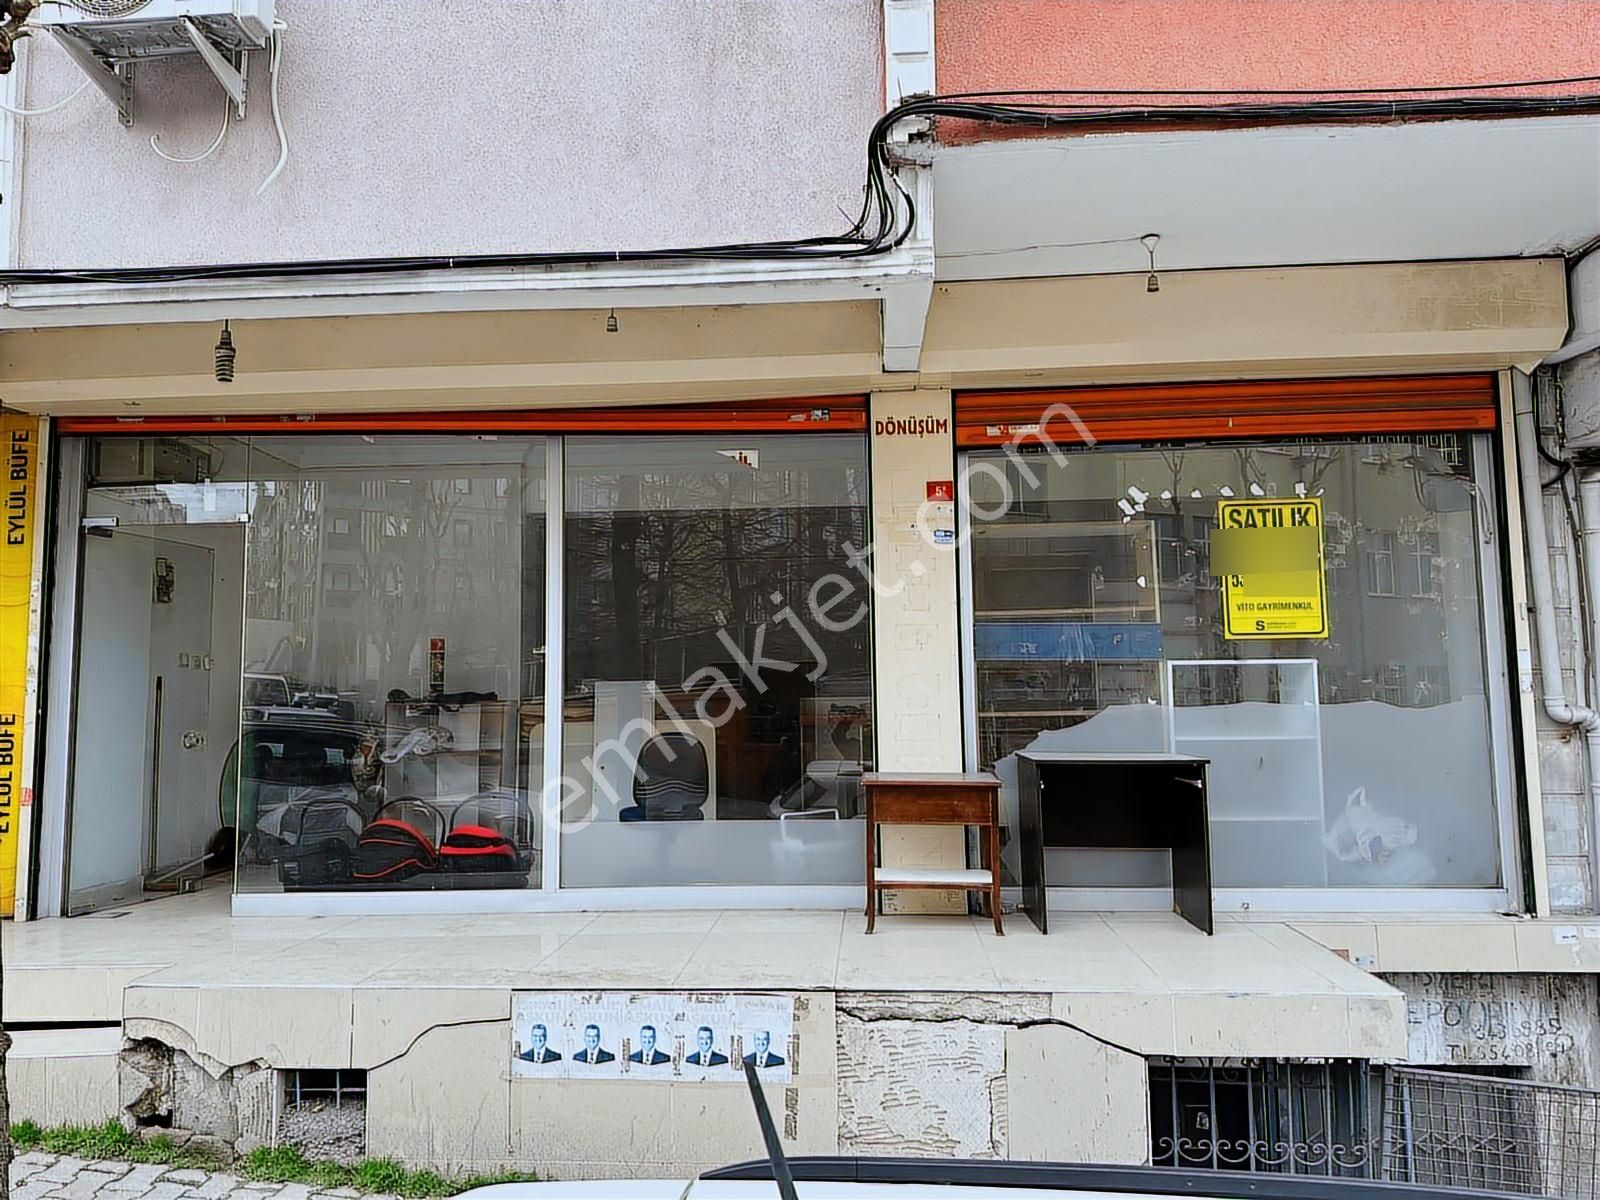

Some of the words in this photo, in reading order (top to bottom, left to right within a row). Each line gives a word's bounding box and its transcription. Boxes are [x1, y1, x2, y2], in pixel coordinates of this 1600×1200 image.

[875, 416, 948, 438] DÖNÜŞÜM
[7, 430, 30, 480] BÜFE
[5, 485, 27, 545] EYLÜL
